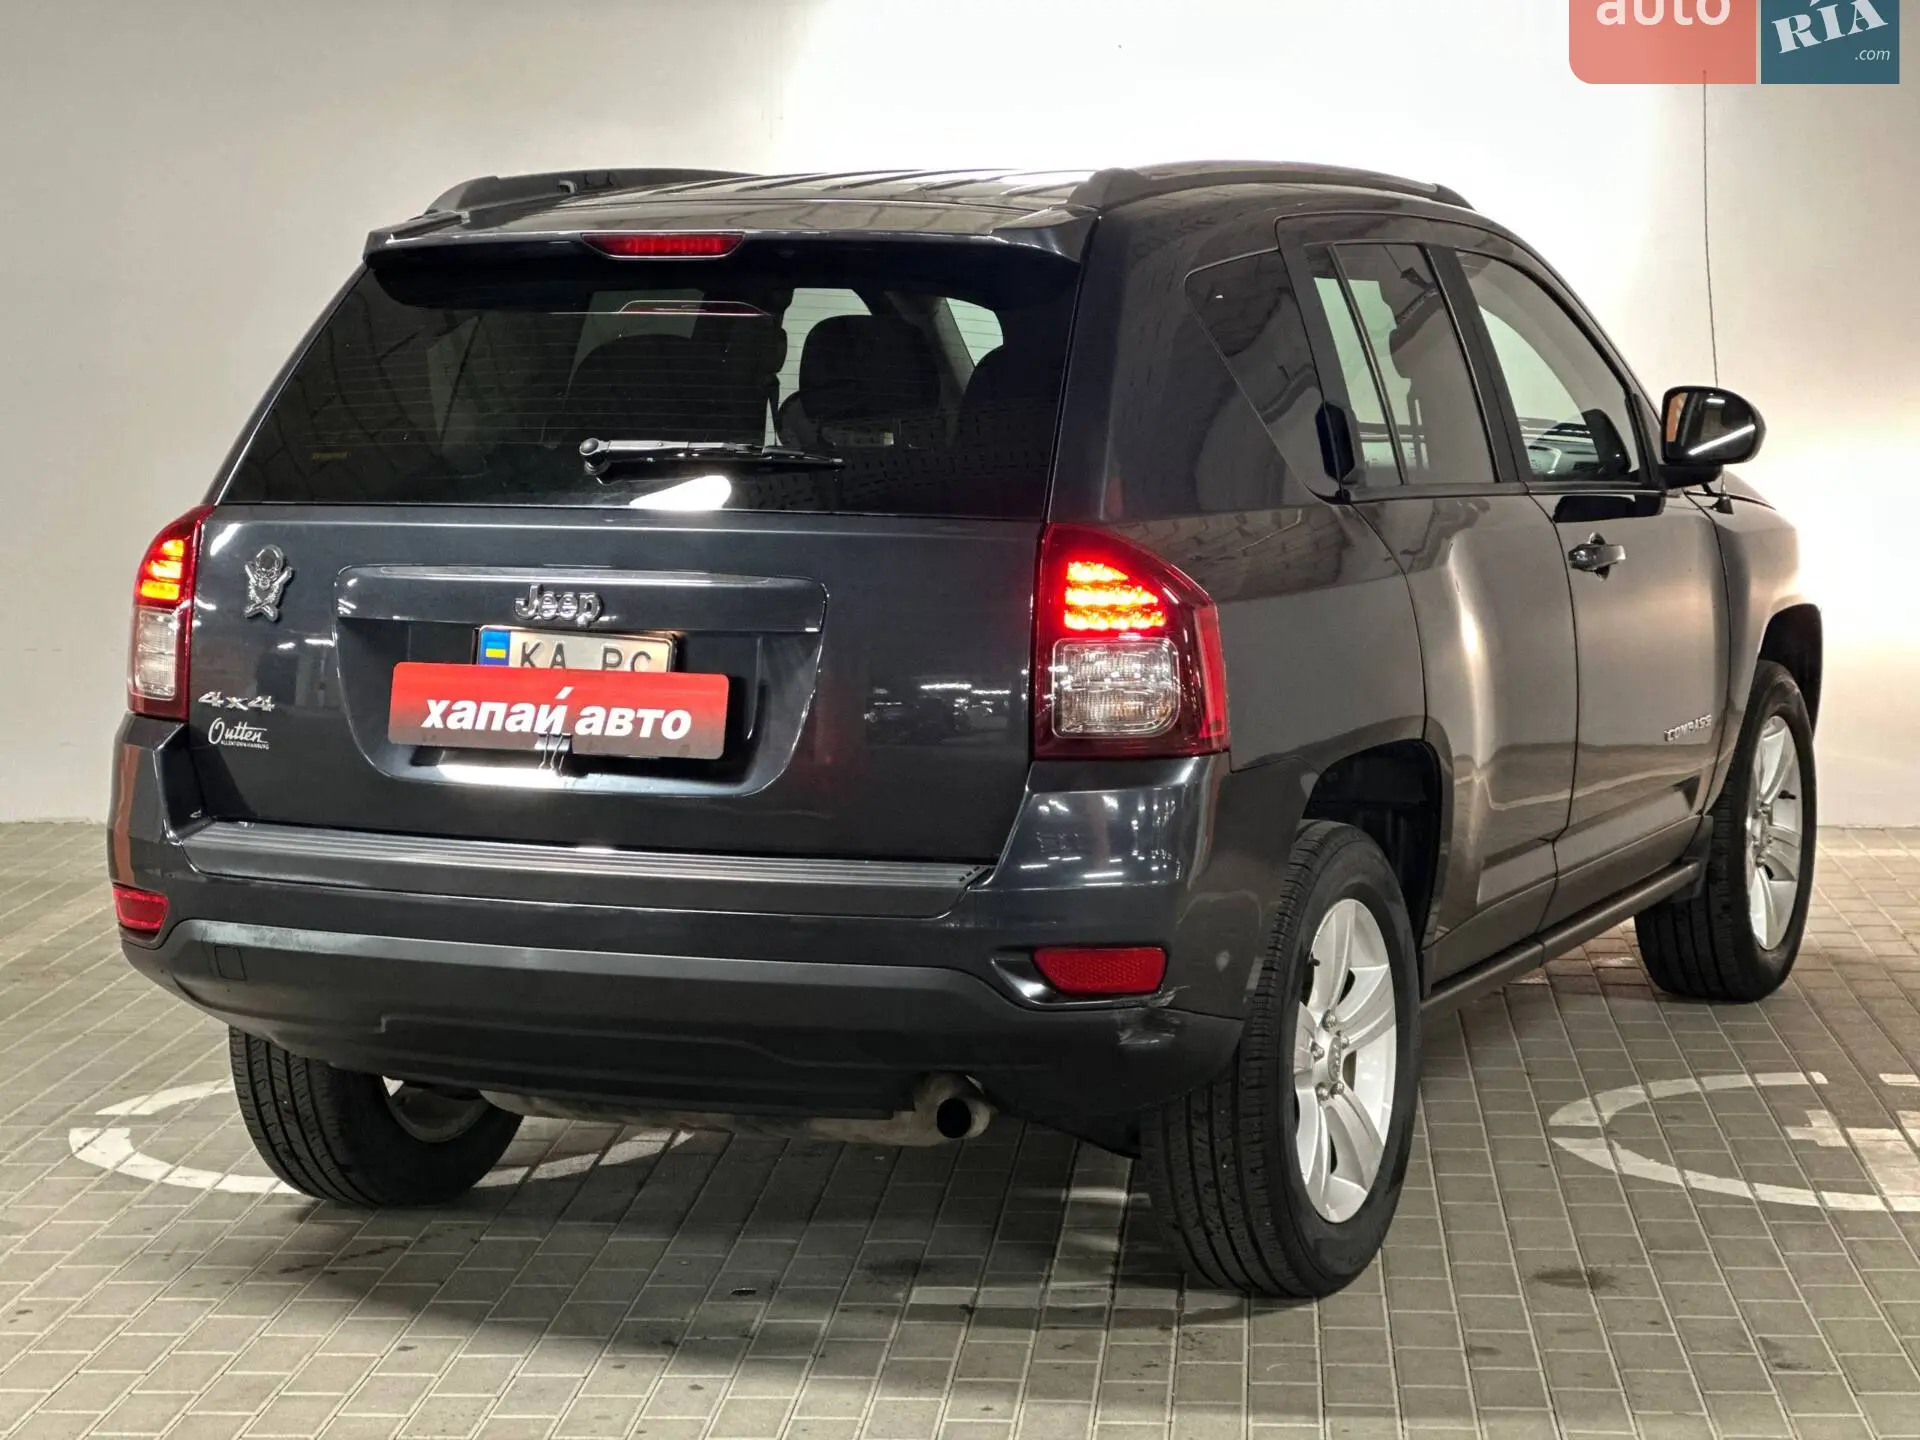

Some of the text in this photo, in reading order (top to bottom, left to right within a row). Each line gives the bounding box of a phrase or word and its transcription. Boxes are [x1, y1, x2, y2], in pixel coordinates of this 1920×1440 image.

[514, 583, 603, 627] Jeep
[521, 641, 567, 670] KA
[575, 708, 692, 740] авто
